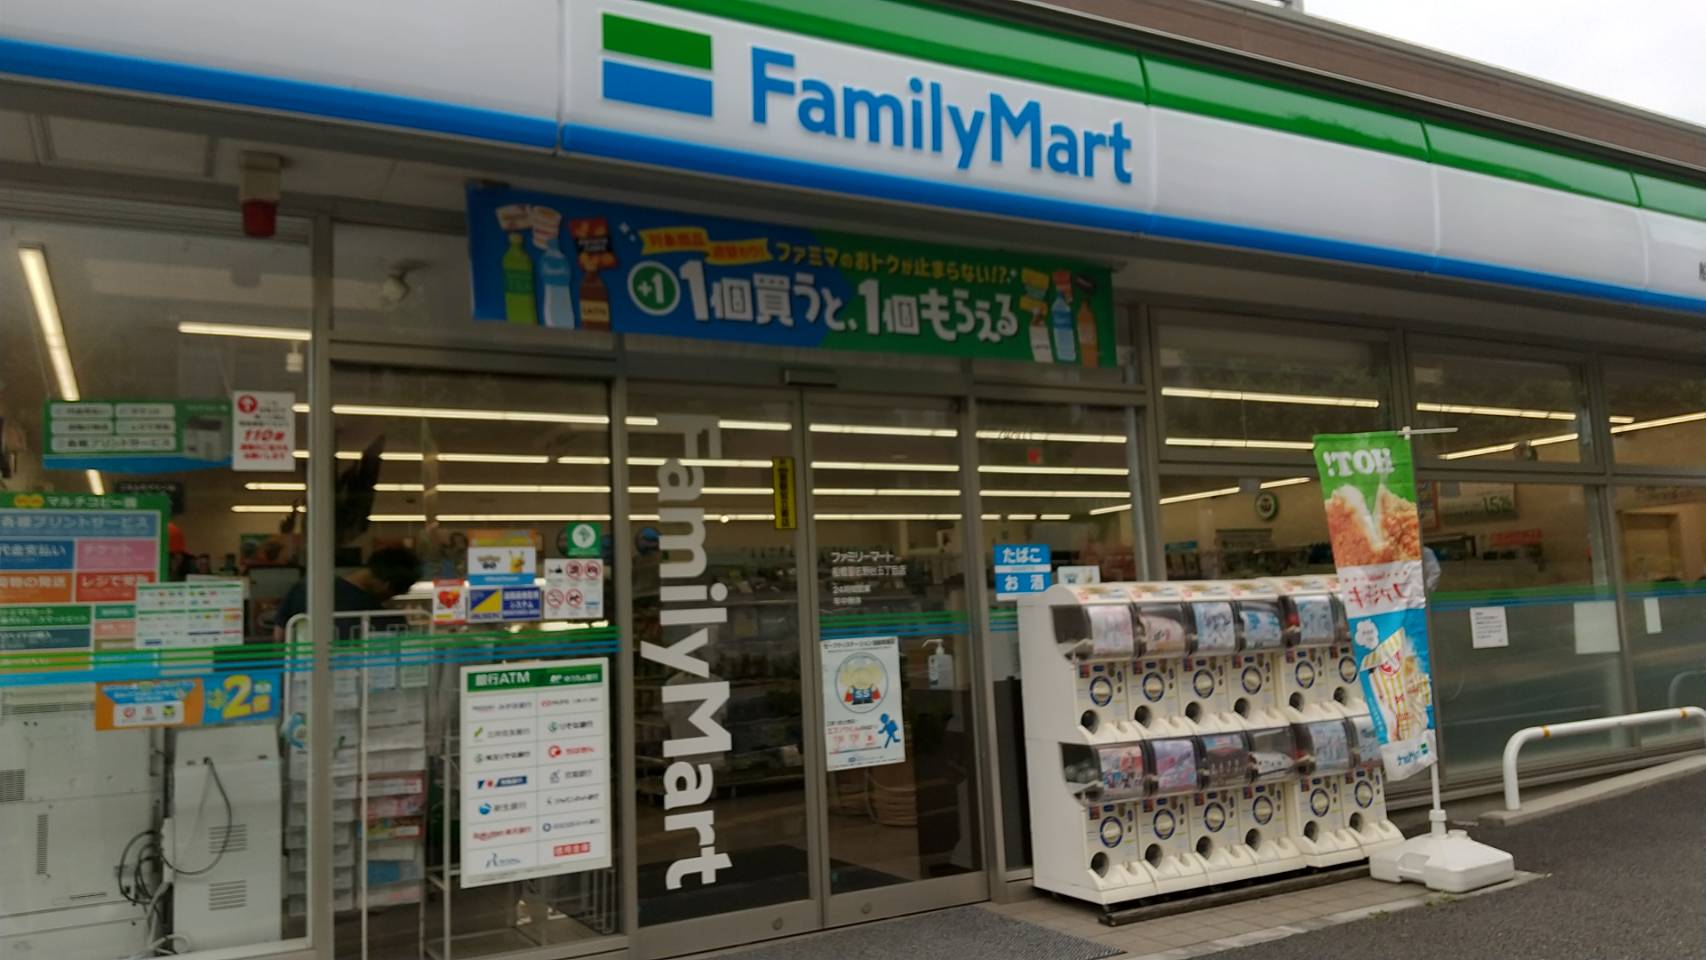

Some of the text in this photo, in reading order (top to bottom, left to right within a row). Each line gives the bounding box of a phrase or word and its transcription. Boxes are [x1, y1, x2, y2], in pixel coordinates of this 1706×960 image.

[751, 46, 1132, 184] FamilyMart
[680, 259, 1018, 342] 1個買うと、1個もらえる
[1002, 547, 1042, 564] たばこ
[475, 671, 531, 687] 銀行ATM
[641, 413, 734, 890] FamilyMart
